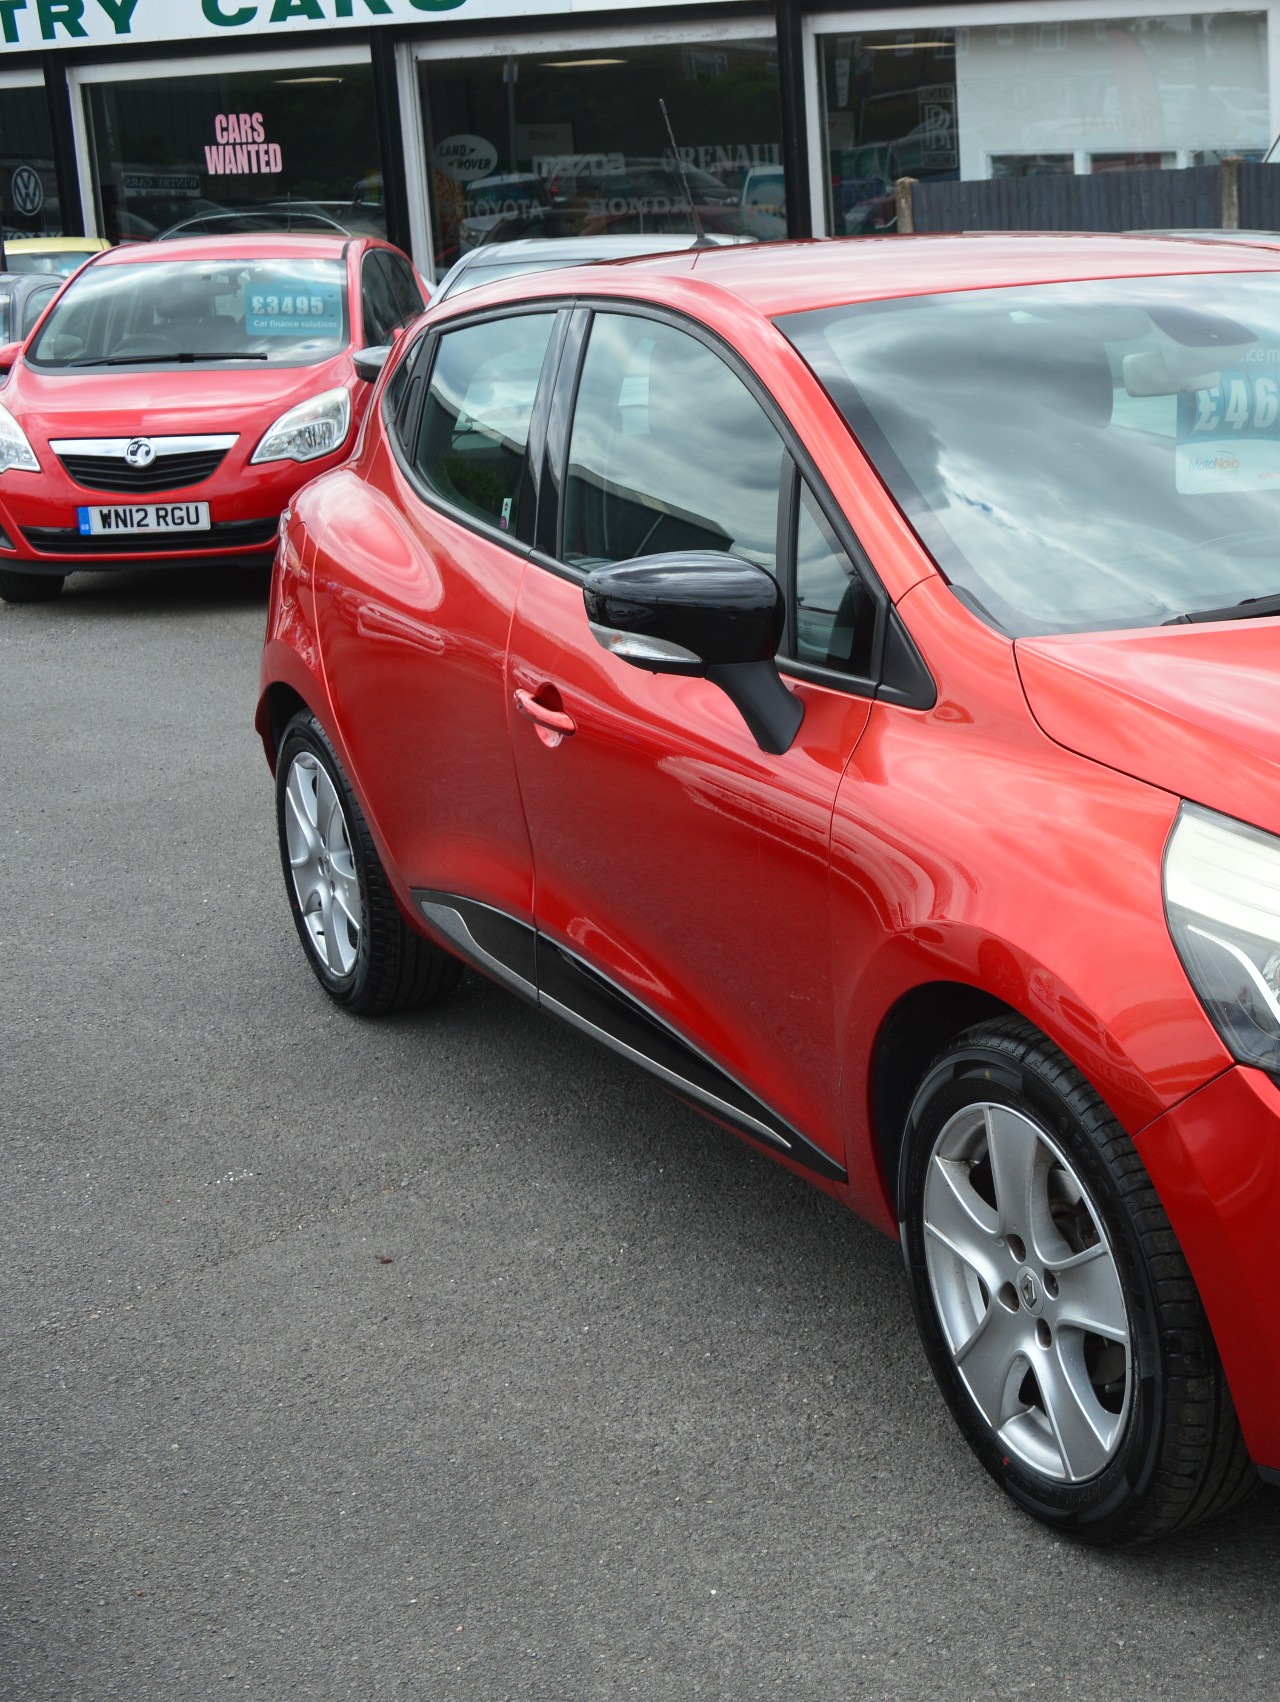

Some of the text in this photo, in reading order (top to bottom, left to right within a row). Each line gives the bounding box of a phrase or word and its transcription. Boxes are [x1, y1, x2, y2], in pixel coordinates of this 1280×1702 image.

[201, 0, 468, 27] CA
[215, 111, 265, 144] CARS
[204, 143, 282, 175] WANTED
[438, 144, 467, 158] LAND
[678, 143, 783, 172] RENAUL
[457, 157, 492, 171] ROVER
[464, 199, 545, 220] TOYOTA
[588, 195, 693, 215] HONDA
[252, 295, 324, 315] £3495
[270, 319, 299, 328] finance
[301, 320, 337, 328] solutions
[99, 505, 200, 529] WN12 RGU
